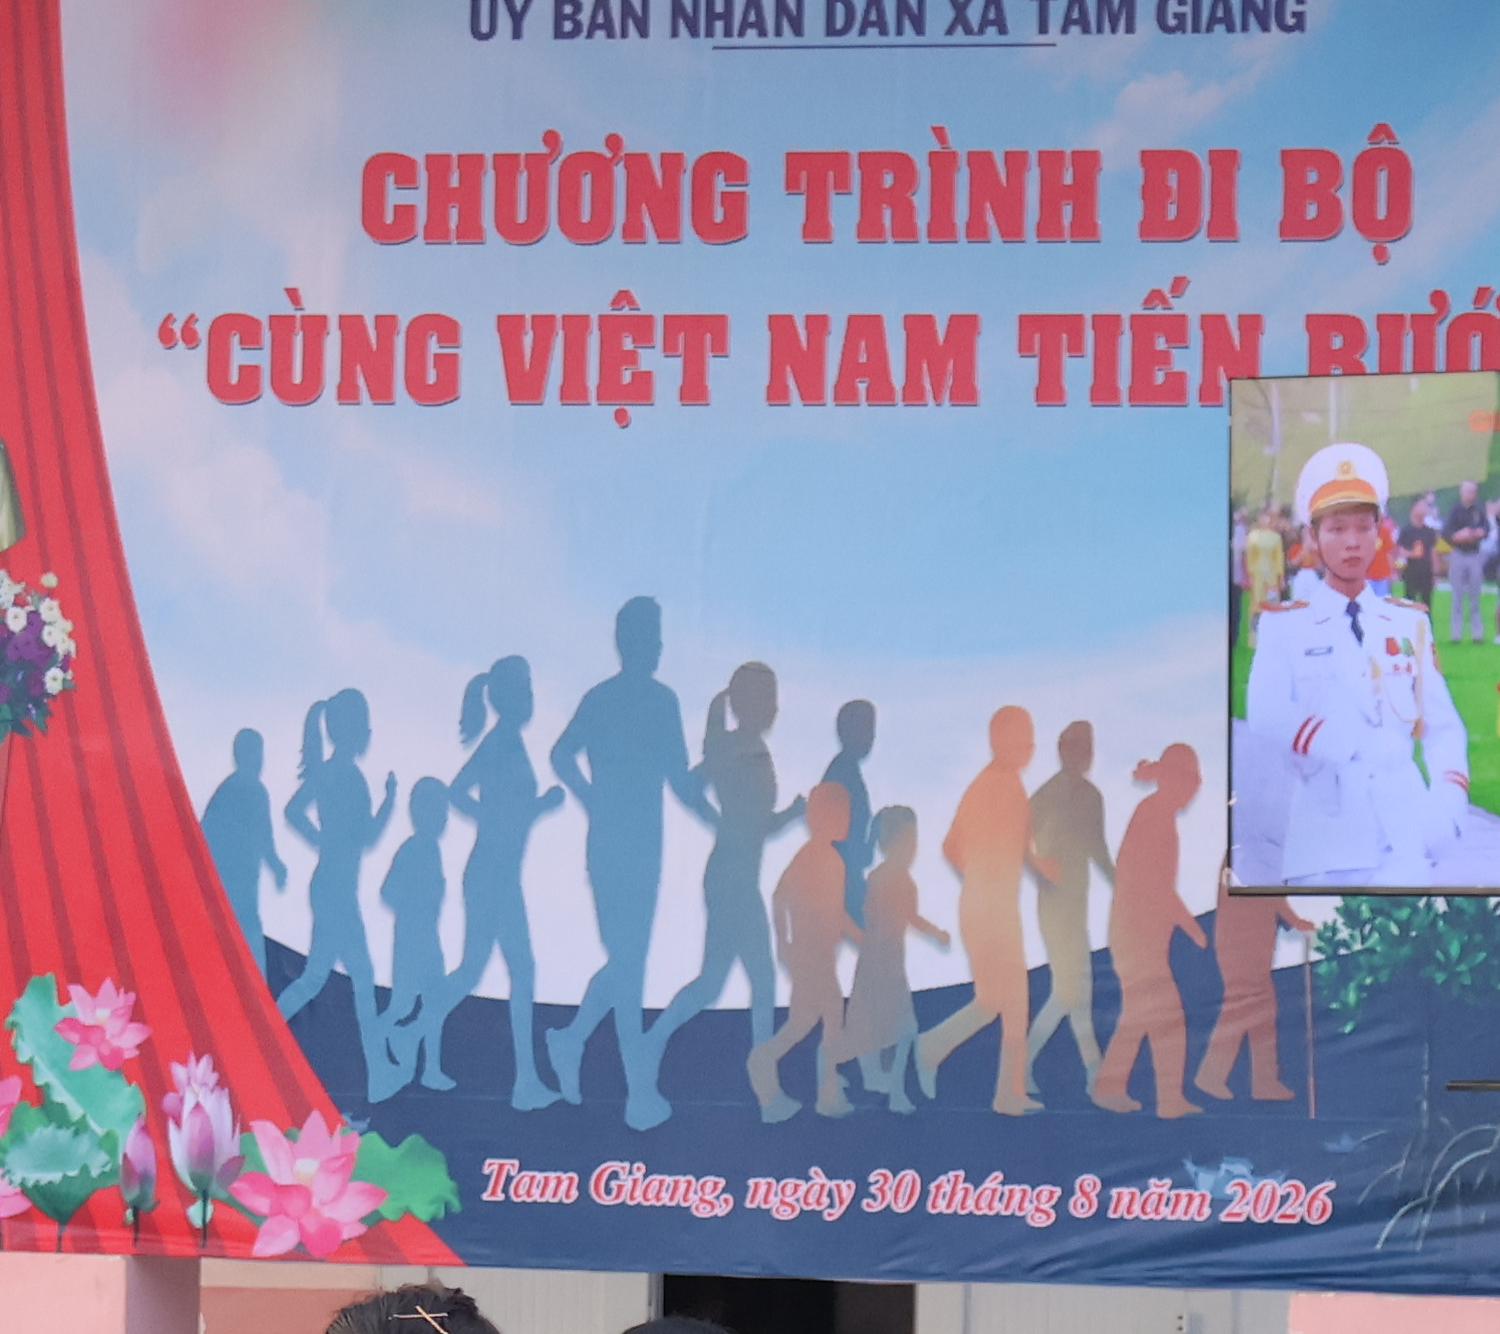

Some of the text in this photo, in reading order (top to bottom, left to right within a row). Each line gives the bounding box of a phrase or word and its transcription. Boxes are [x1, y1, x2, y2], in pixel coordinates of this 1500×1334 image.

[361, 122, 1414, 265] CHƯƠNG TRÌNH ĐI BỘ
[497, 289, 730, 429] VIỆT
[766, 313, 982, 407] NAM
[1018, 276, 1265, 407] TIẾN
[481, 1158, 1334, 1227] Tam Giang, ngày 30 tháng 8 năm 2026
